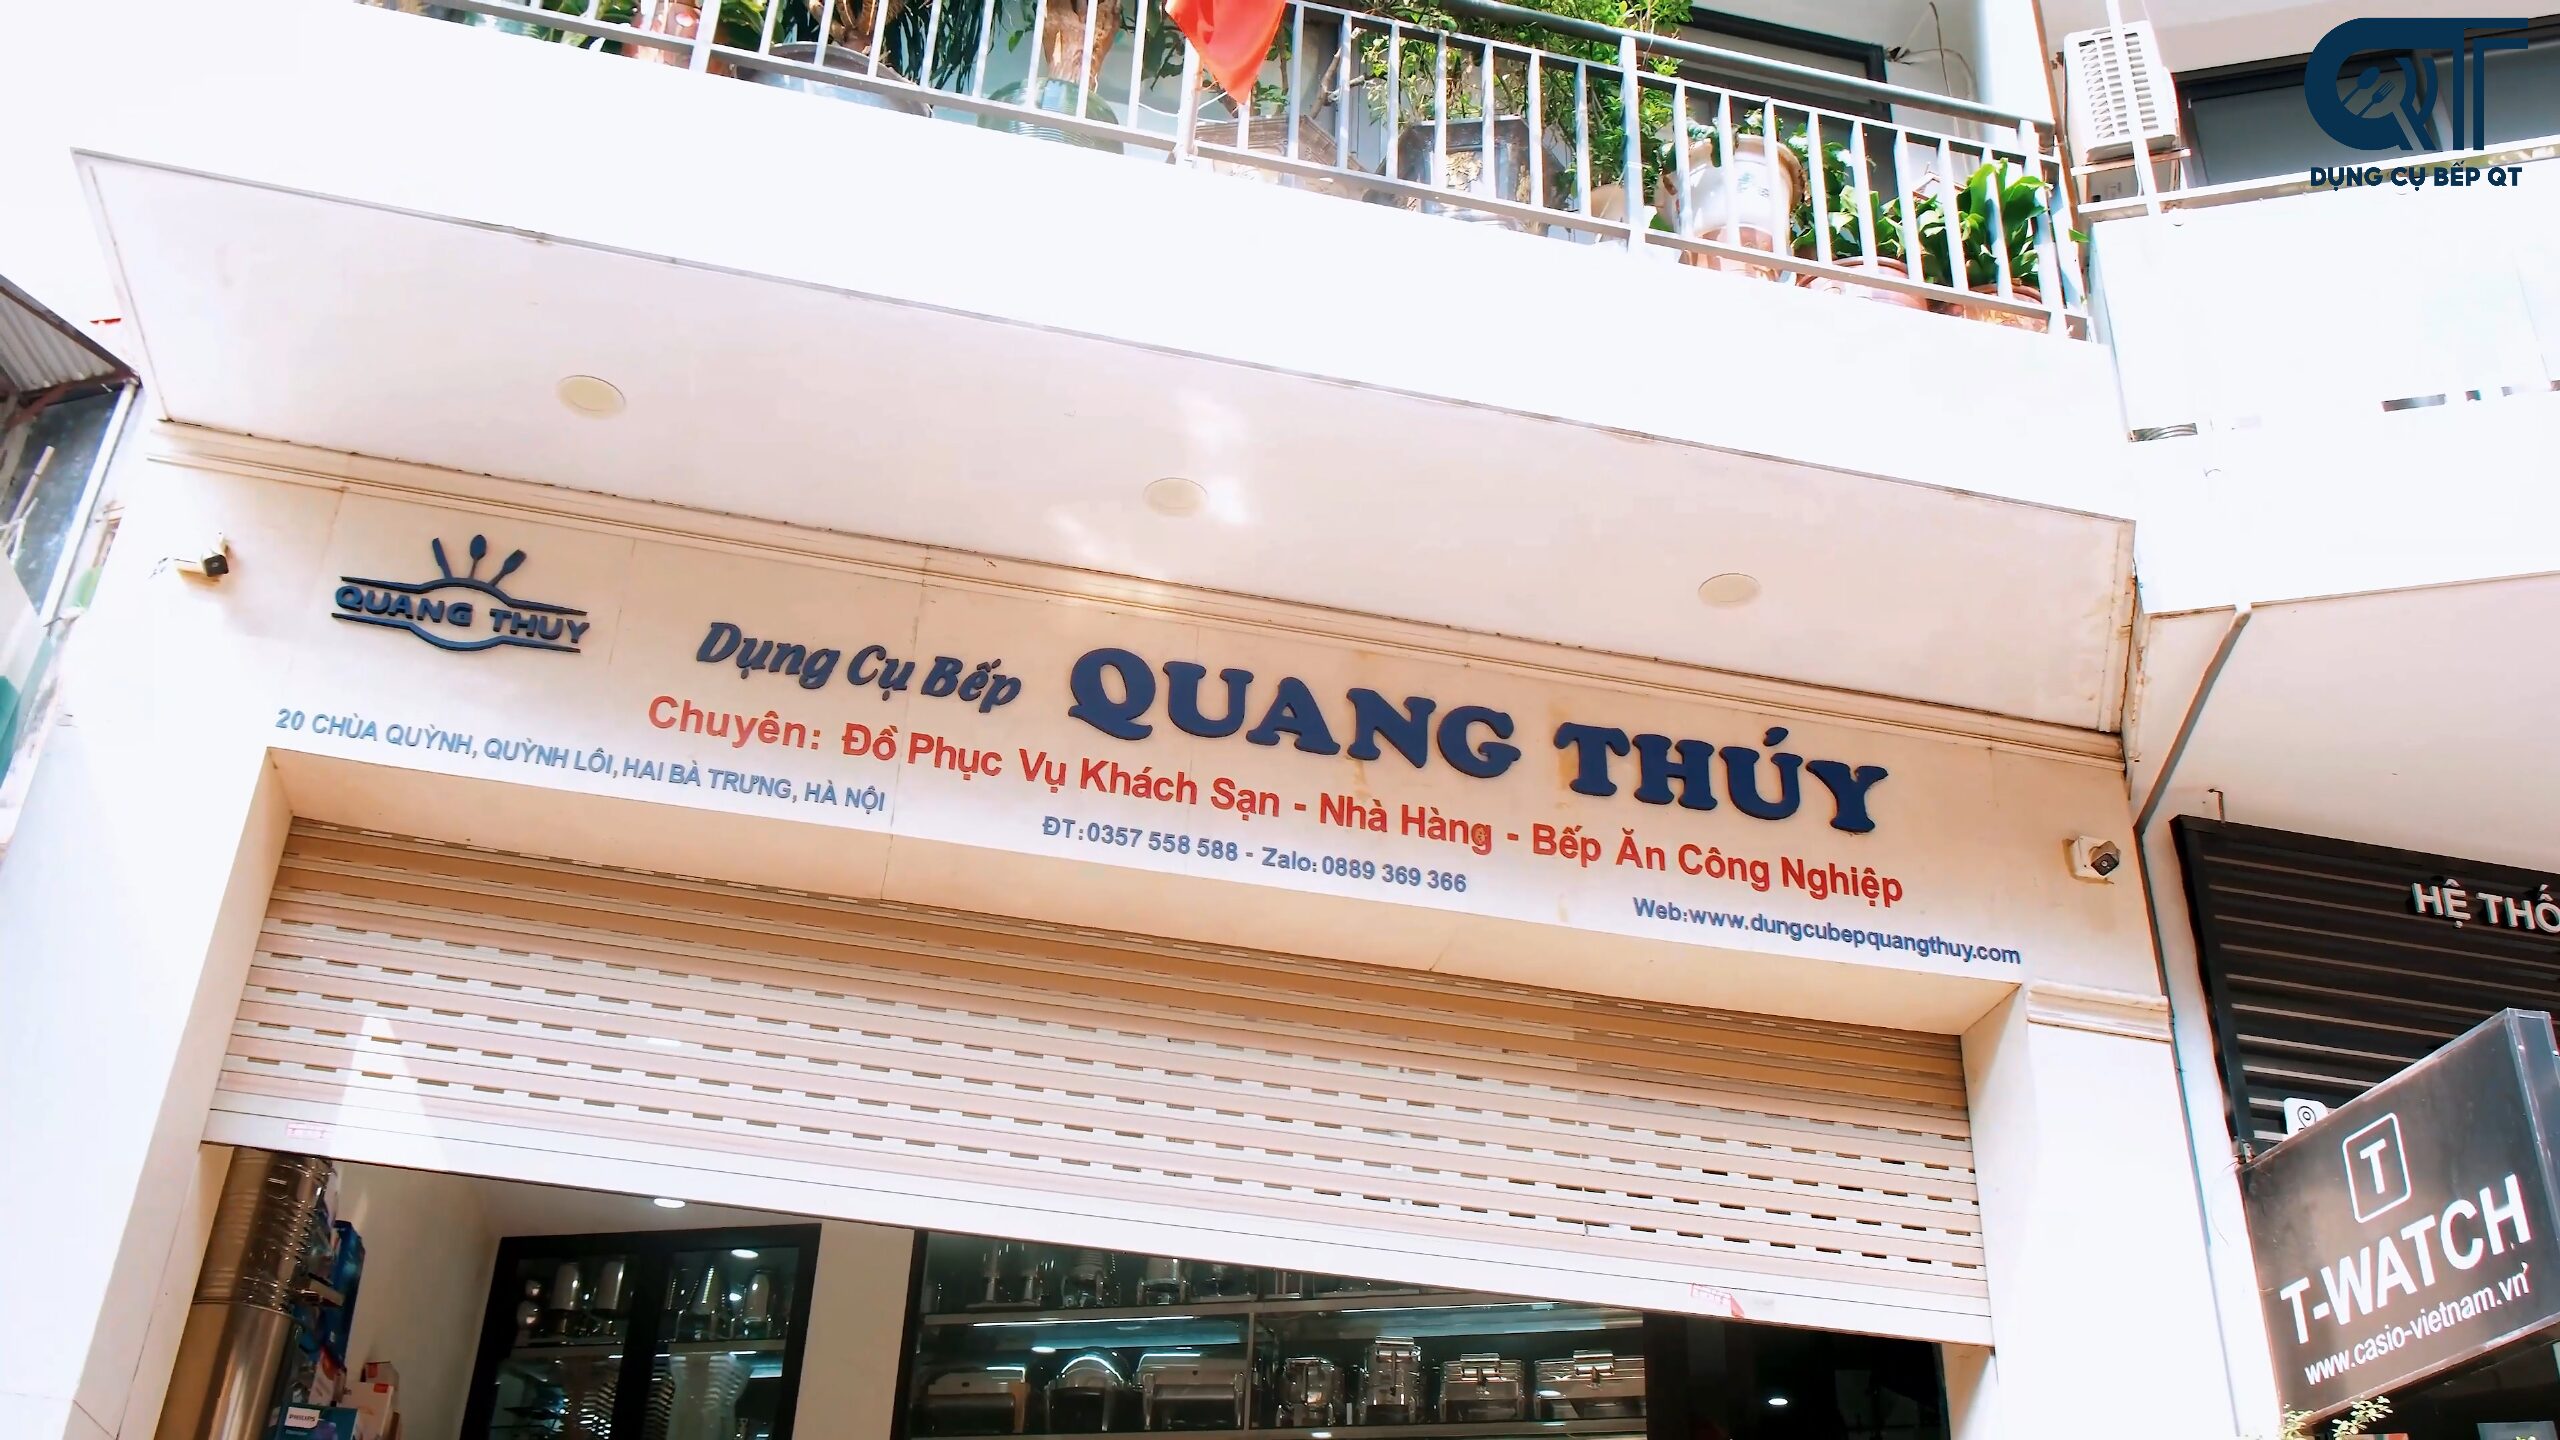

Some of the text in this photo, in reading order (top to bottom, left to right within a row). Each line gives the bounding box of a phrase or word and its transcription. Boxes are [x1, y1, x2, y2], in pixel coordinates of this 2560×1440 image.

[335, 585, 590, 645] QUANG THUY
[275, 708, 885, 814] 20 CHÙA QUỲNH, QUỲNH LÔI, HAI BÀ TRƯNG, HÀ NỘI
[696, 622, 1888, 833] Dụng Cụ Bếp QUANG THÚY
[649, 696, 820, 749] Chuyên:
[842, 723, 897, 761] Đồ
[908, 732, 1002, 780] Phục
[1019, 748, 1066, 793] Vụ
[1080, 758, 1197, 805] Khách
[1211, 777, 1279, 821] Sạn
[1320, 792, 1387, 833] Nhà
[1402, 804, 1491, 855] Hàng
[1506, 833, 1519, 841] -
[1533, 823, 1601, 867] Bếp
[1616, 827, 1665, 871] Ăn
[1678, 843, 1770, 892] Công
[1781, 856, 1902, 906] Nghiệp
[1148, 831, 1191, 854] 558
[1196, 837, 1238, 861] 588
[1382, 864, 1421, 886] 369
[1427, 870, 1467, 893] 366
[2411, 878, 2471, 929] HỆ
[2280, 1174, 2532, 1344] T-WATCH
[2304, 1270, 2530, 1385] www.casio-vietnam.vn
